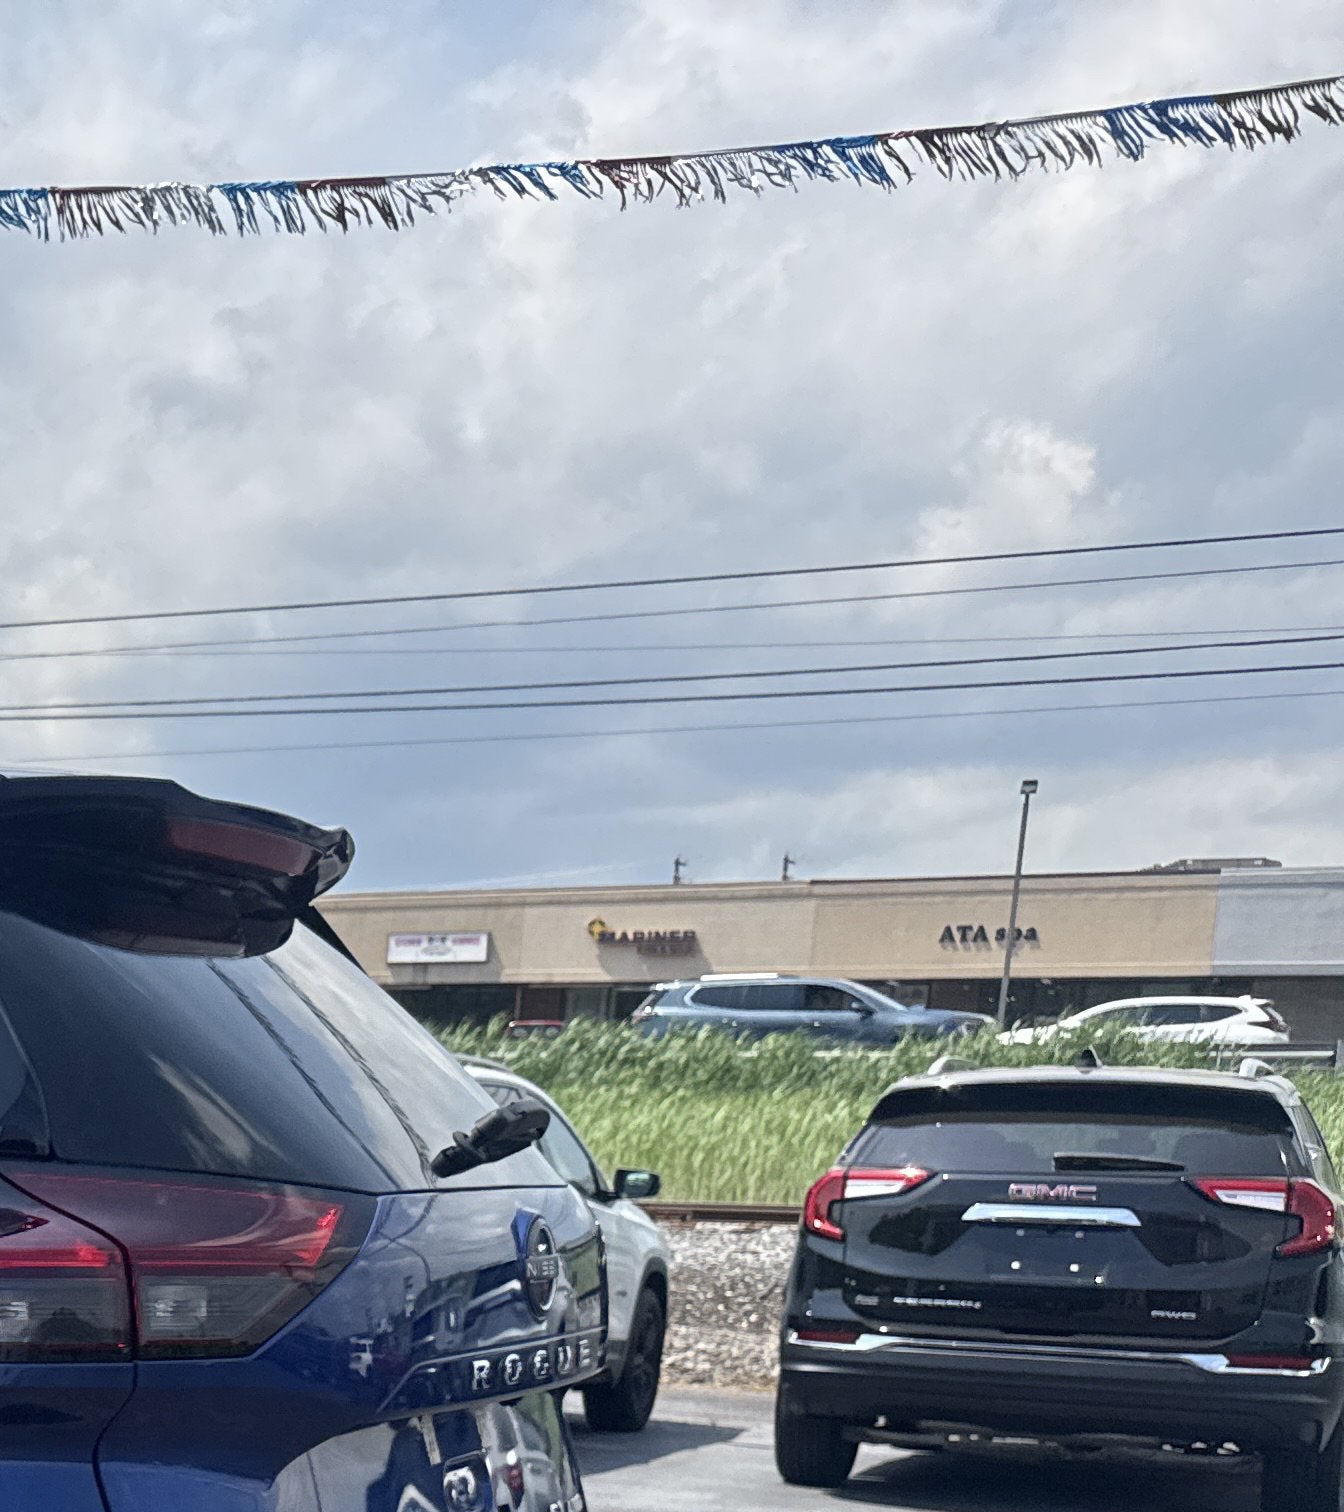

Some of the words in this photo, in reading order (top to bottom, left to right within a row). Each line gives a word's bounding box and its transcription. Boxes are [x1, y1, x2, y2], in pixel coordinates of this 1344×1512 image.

[598, 930, 696, 943] MARINER
[939, 925, 989, 943] ATA
[1008, 1183, 1097, 1201] GMC
[472, 1339, 591, 1391] ROGUE
